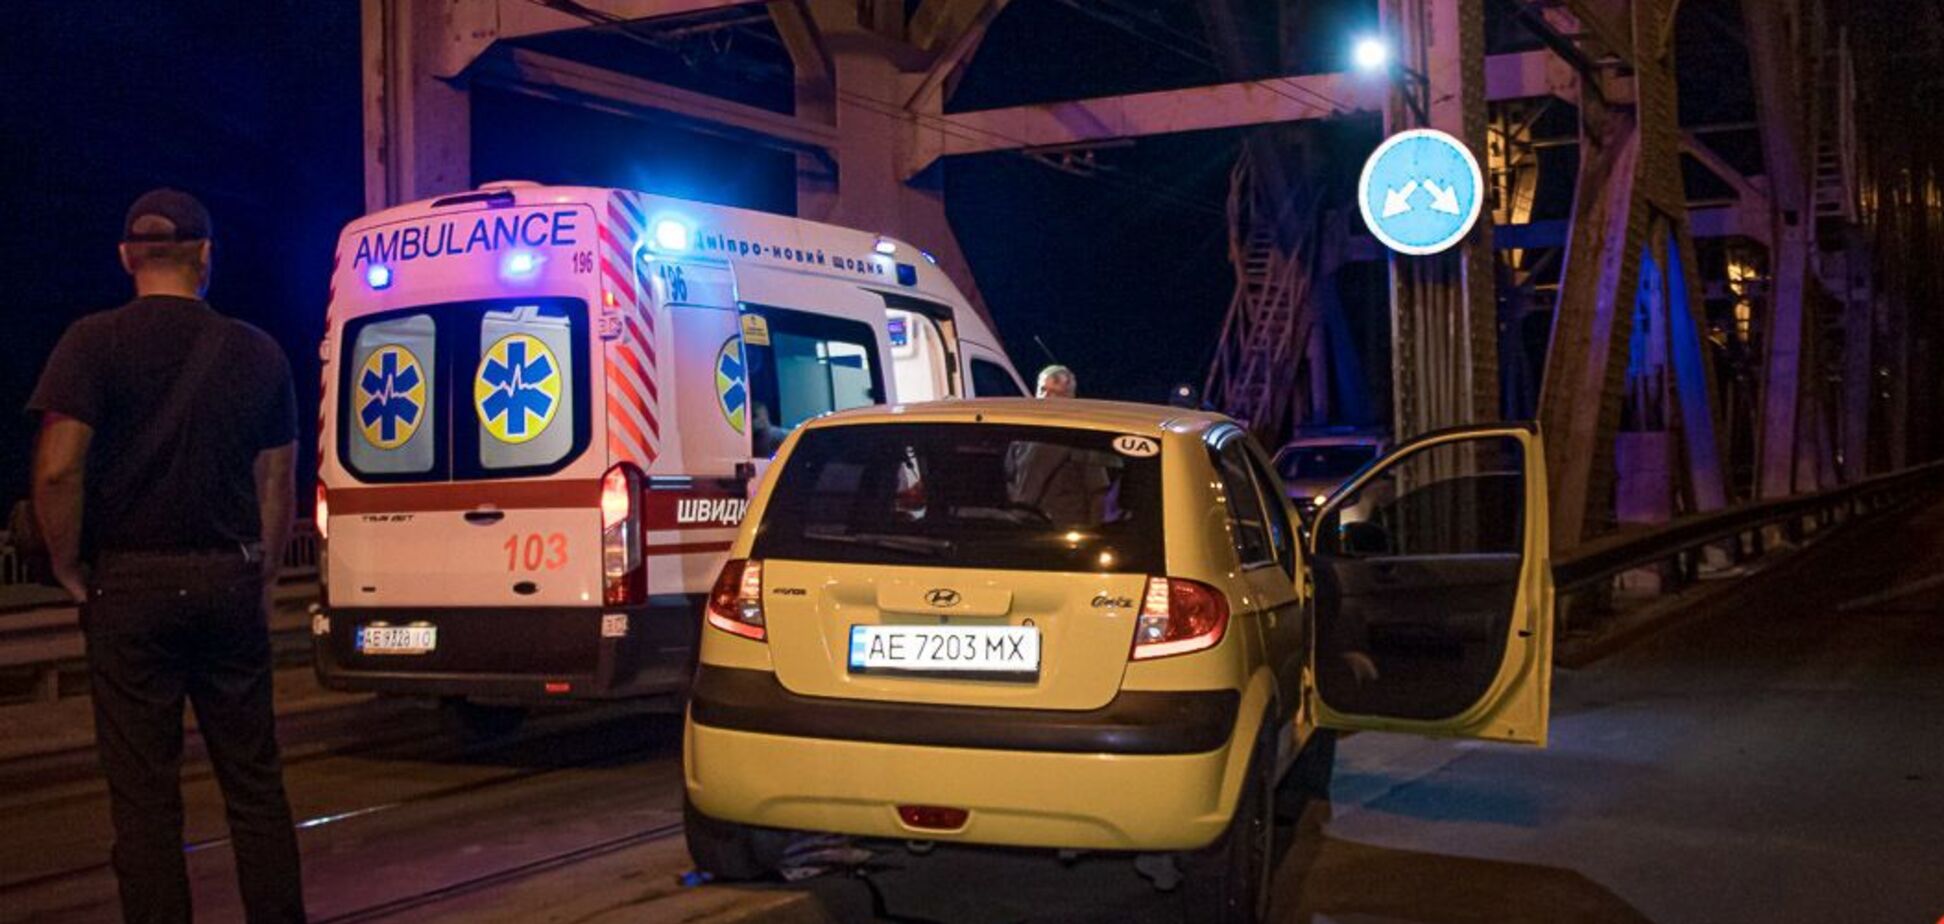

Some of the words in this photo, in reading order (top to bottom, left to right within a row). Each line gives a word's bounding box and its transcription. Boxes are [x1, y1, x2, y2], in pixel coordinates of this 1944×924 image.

[353, 211, 578, 269] AMBULANCE
[572, 251, 594, 274] 196
[832, 255, 884, 275] щодня
[660, 264, 688, 302] 196
[1121, 438, 1151, 453] UA
[504, 532, 569, 572] 103
[868, 633, 906, 661] AE
[915, 633, 976, 662] 7203
[986, 634, 1025, 662] MX
